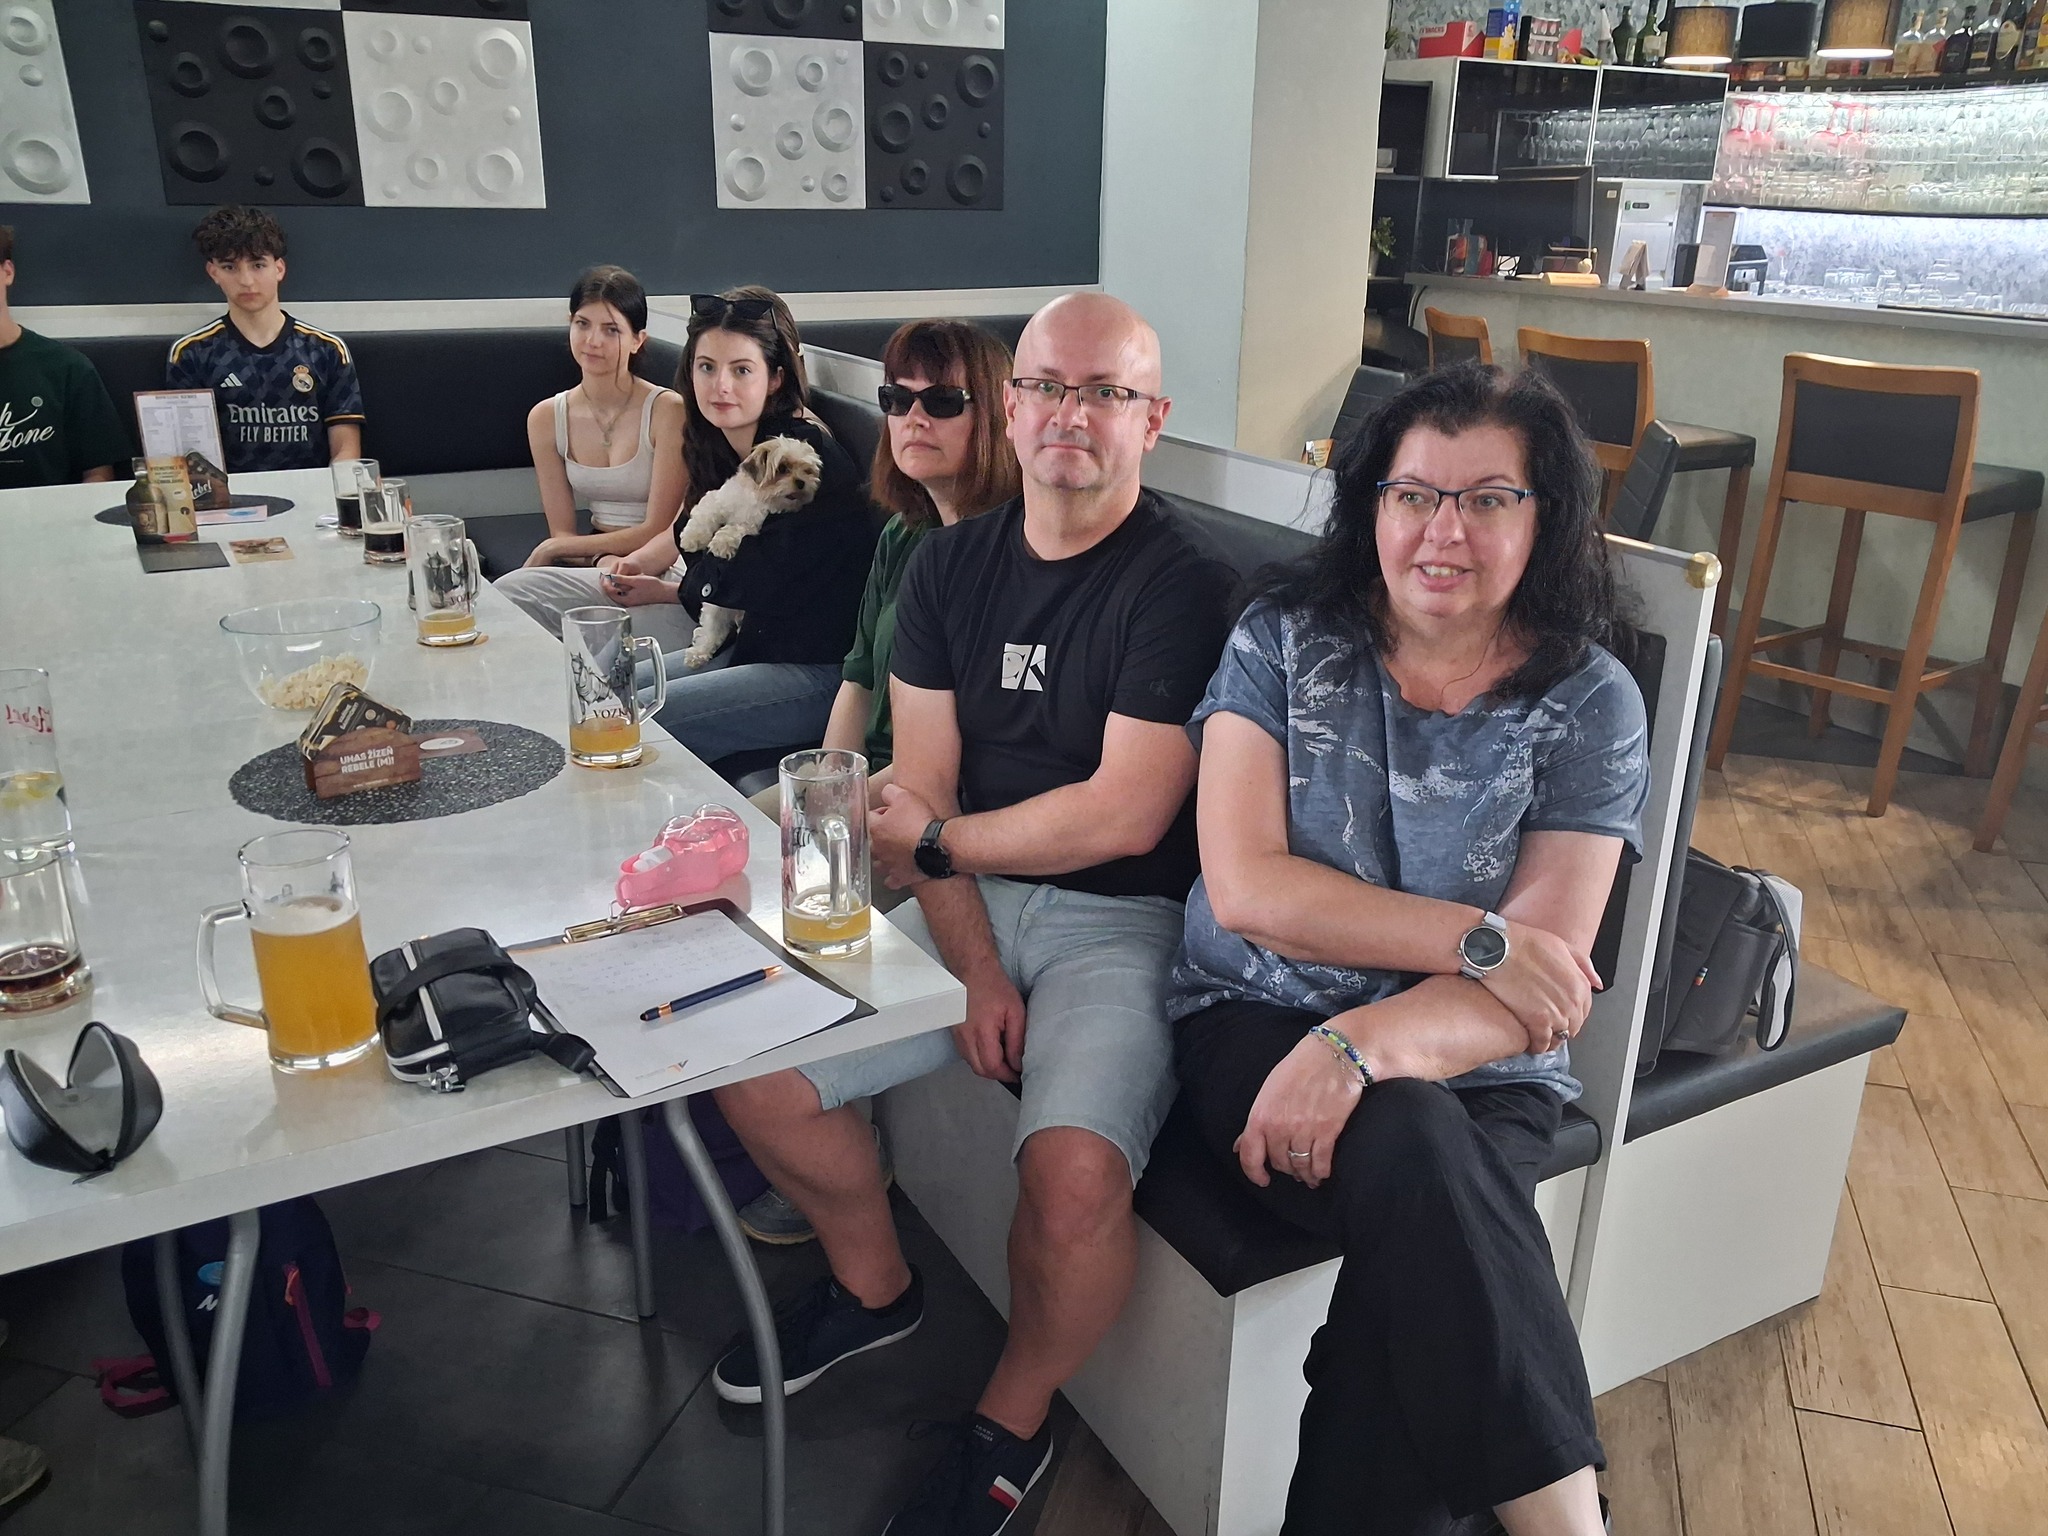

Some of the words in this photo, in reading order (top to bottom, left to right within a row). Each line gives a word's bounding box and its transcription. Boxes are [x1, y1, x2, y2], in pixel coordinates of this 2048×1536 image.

[226, 402, 319, 423] Emirates
[240, 426, 259, 442] FLY
[264, 425, 308, 443] BETTER
[190, 480, 212, 500] ebel
[341, 760, 375, 774] REBELE
